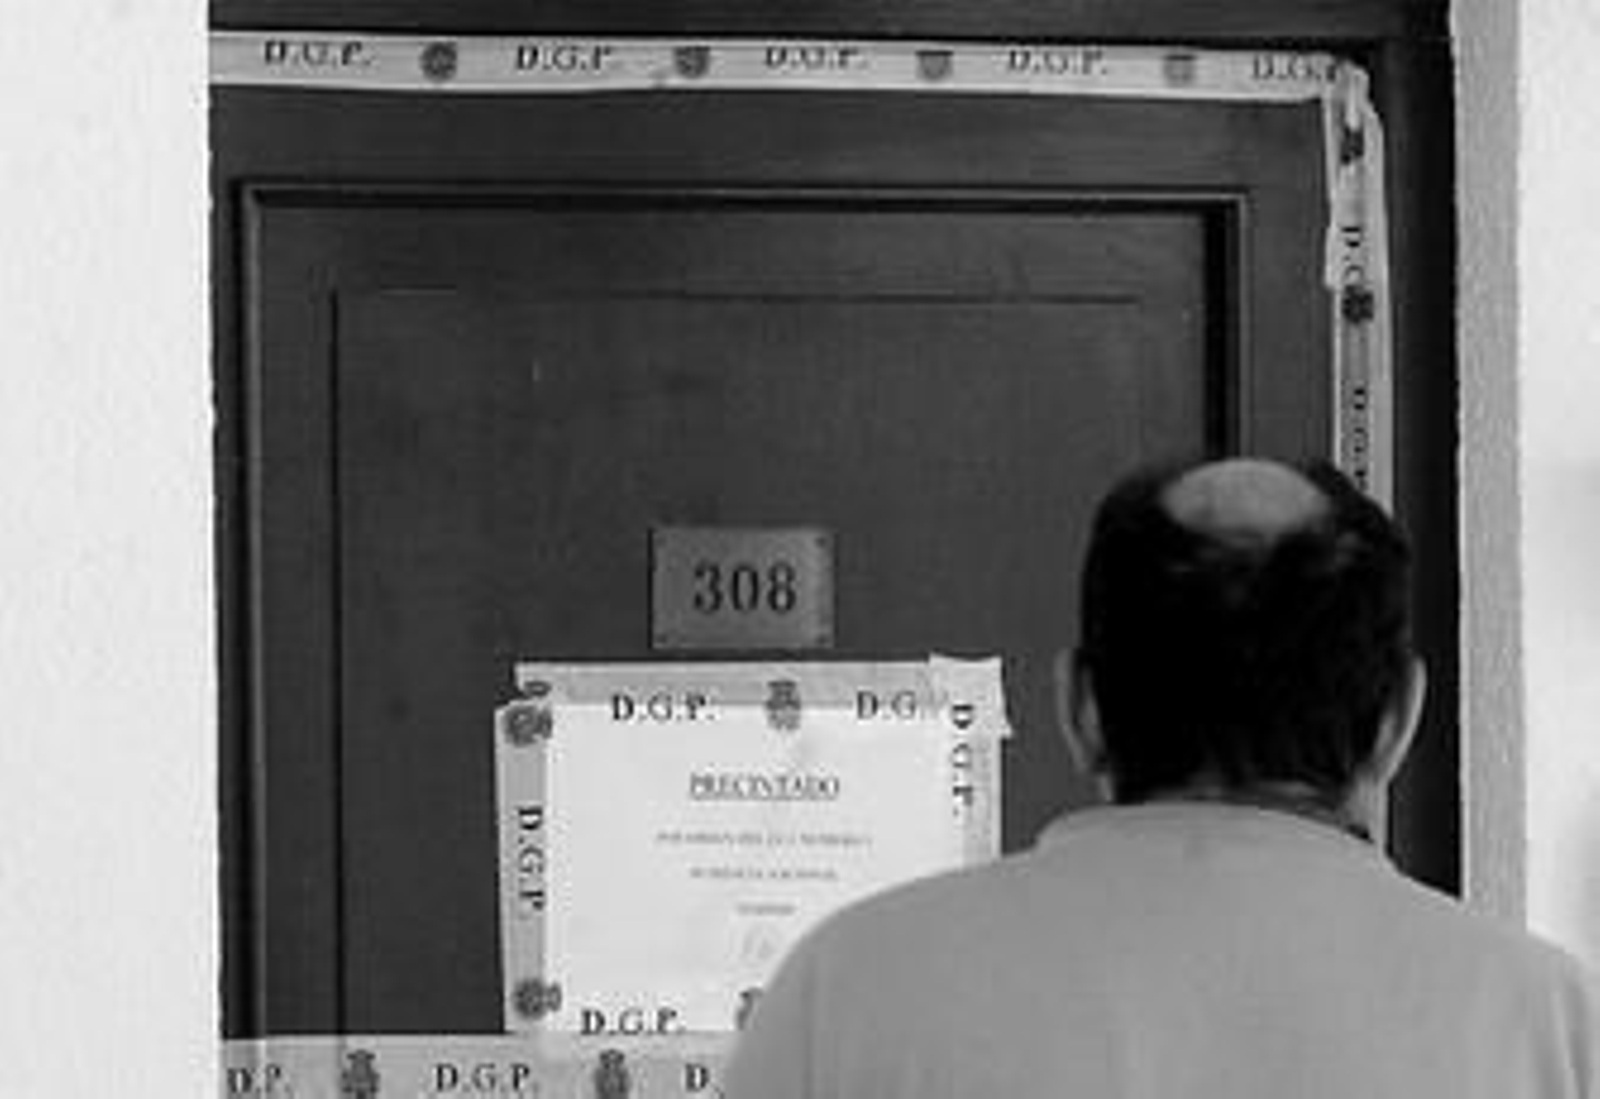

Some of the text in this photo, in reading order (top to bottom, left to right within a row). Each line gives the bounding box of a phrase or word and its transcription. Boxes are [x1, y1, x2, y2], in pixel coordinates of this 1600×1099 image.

[694, 561, 797, 615] 308
[611, 693, 716, 721] D.G.P.
[580, 1007, 685, 1037] D.G.P.
[435, 1063, 540, 1094] D.G.P.
